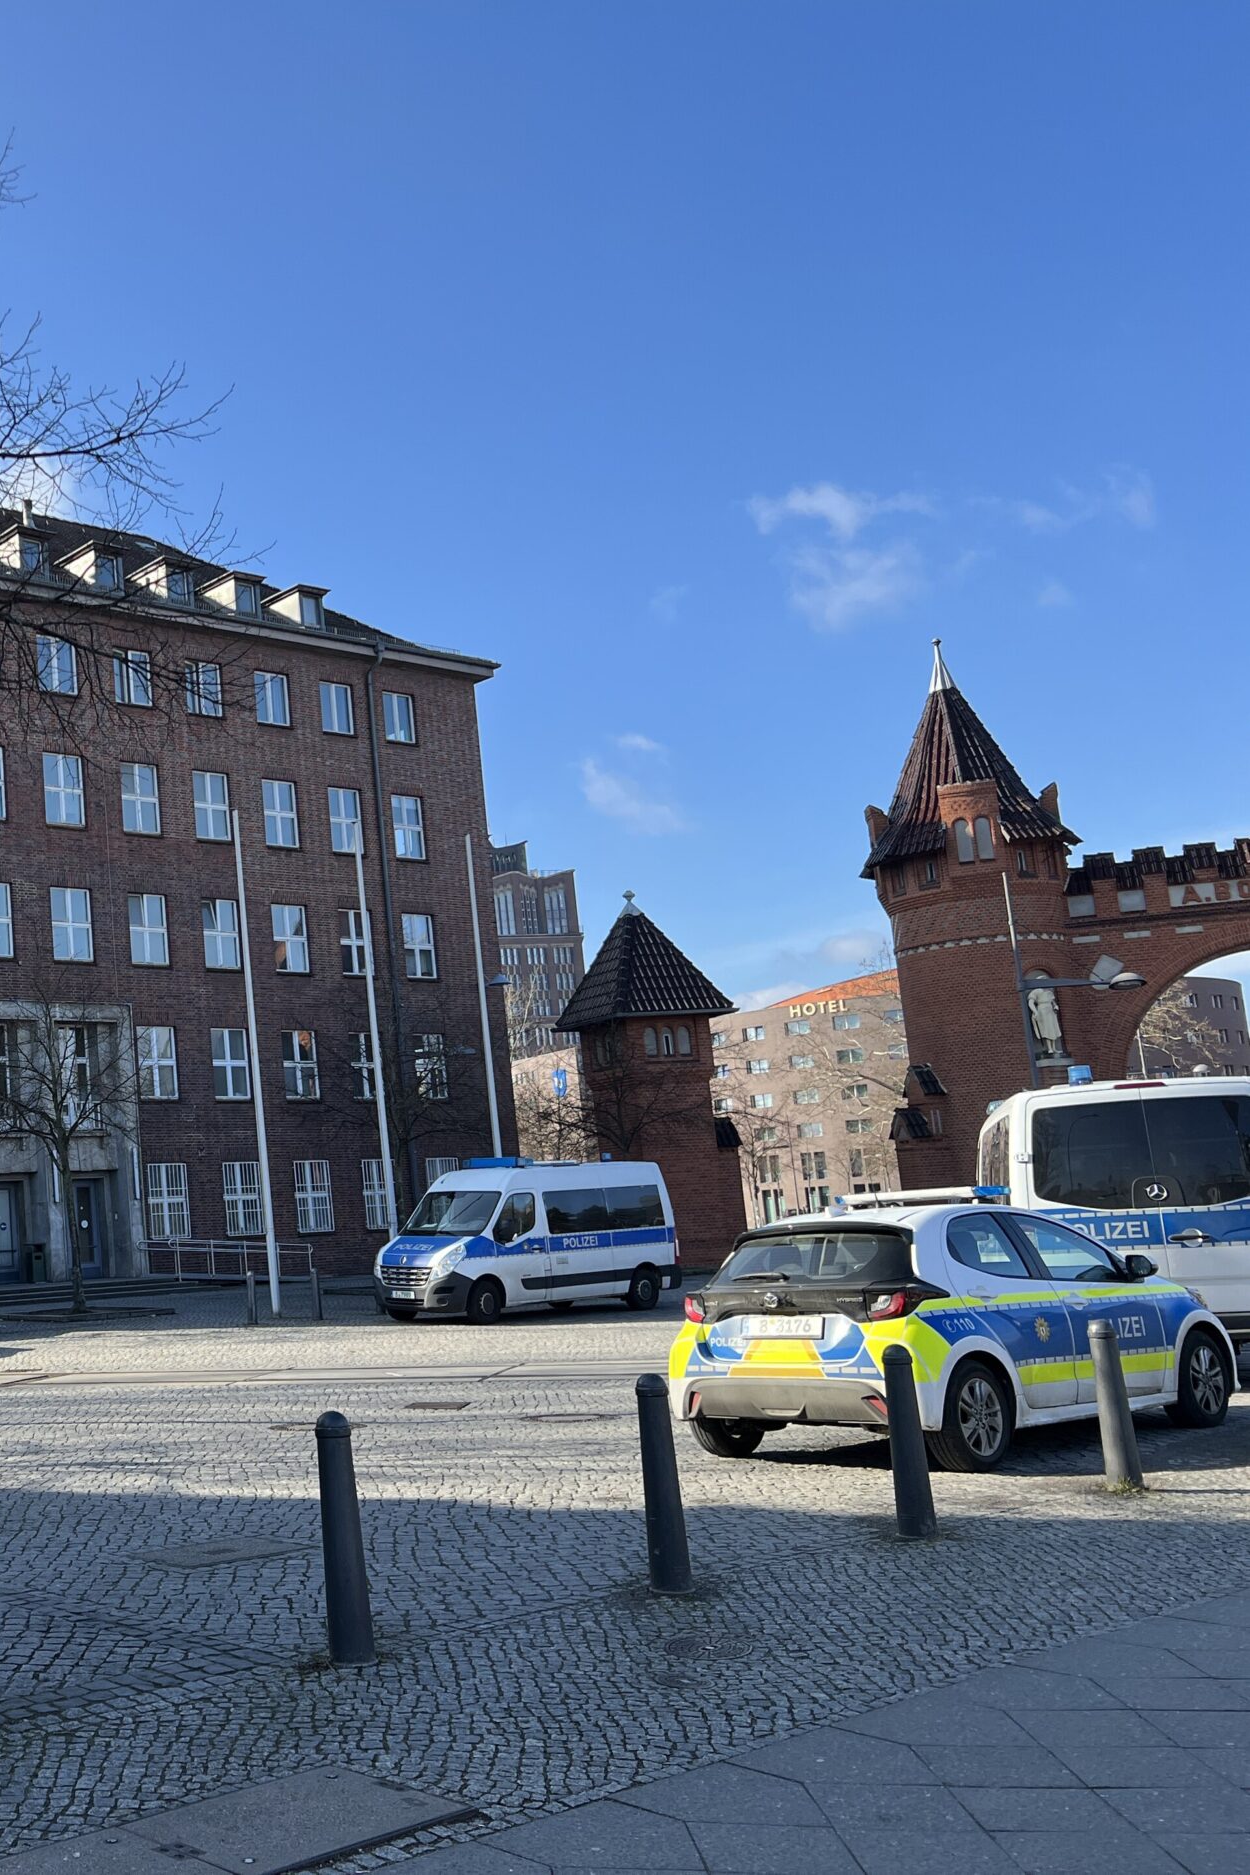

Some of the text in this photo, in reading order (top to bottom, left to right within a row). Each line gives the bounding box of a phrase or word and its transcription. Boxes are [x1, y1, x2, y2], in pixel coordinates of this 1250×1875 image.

[790, 999, 848, 1018] HOTEL
[1072, 1220, 1151, 1240] OLIZEI
[393, 1243, 435, 1251] POLIZEI
[562, 1235, 599, 1249] POLIZEI
[953, 1317, 976, 1331] 110
